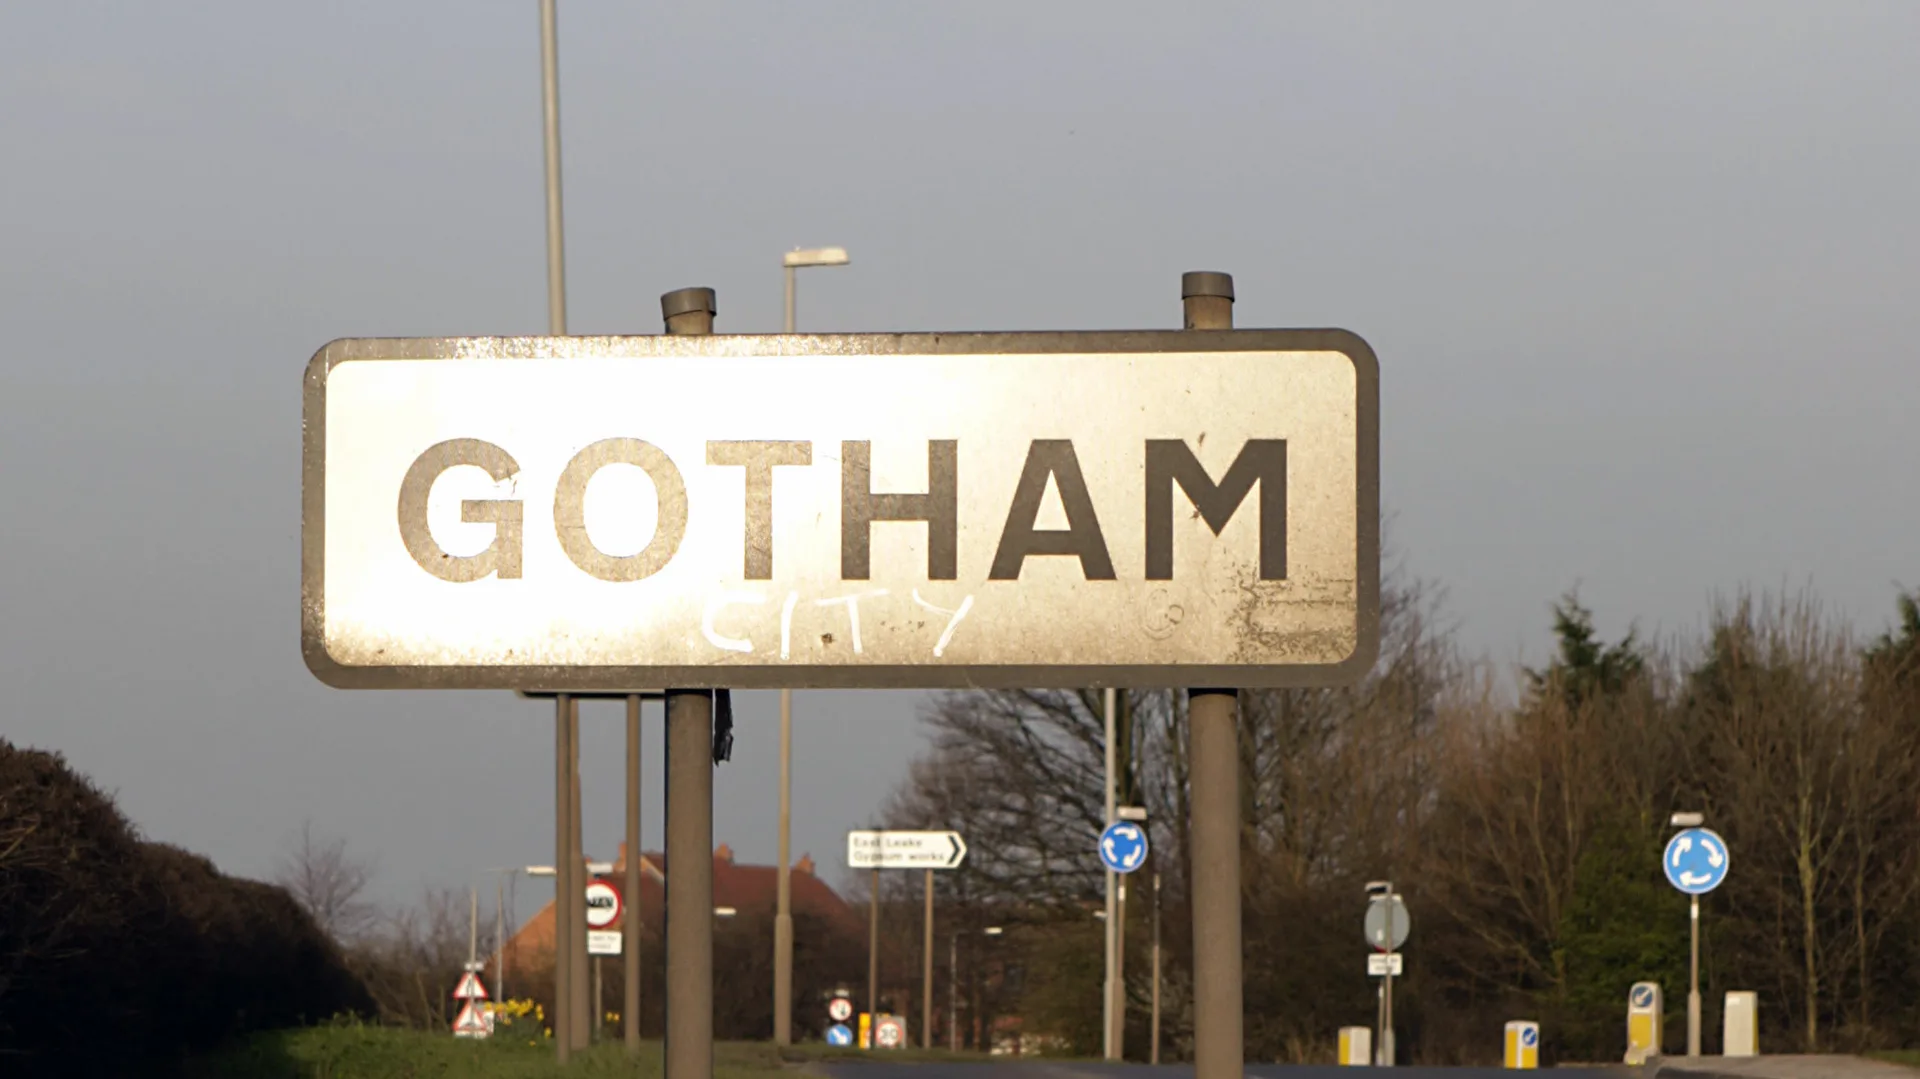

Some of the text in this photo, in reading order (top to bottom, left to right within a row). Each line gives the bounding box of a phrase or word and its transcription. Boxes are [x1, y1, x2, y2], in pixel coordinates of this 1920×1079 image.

[397, 437, 1287, 582] GOTHAM
[702, 588, 974, 660] CITY
[853, 837, 922, 847] East Leake
[908, 851, 944, 861] works
